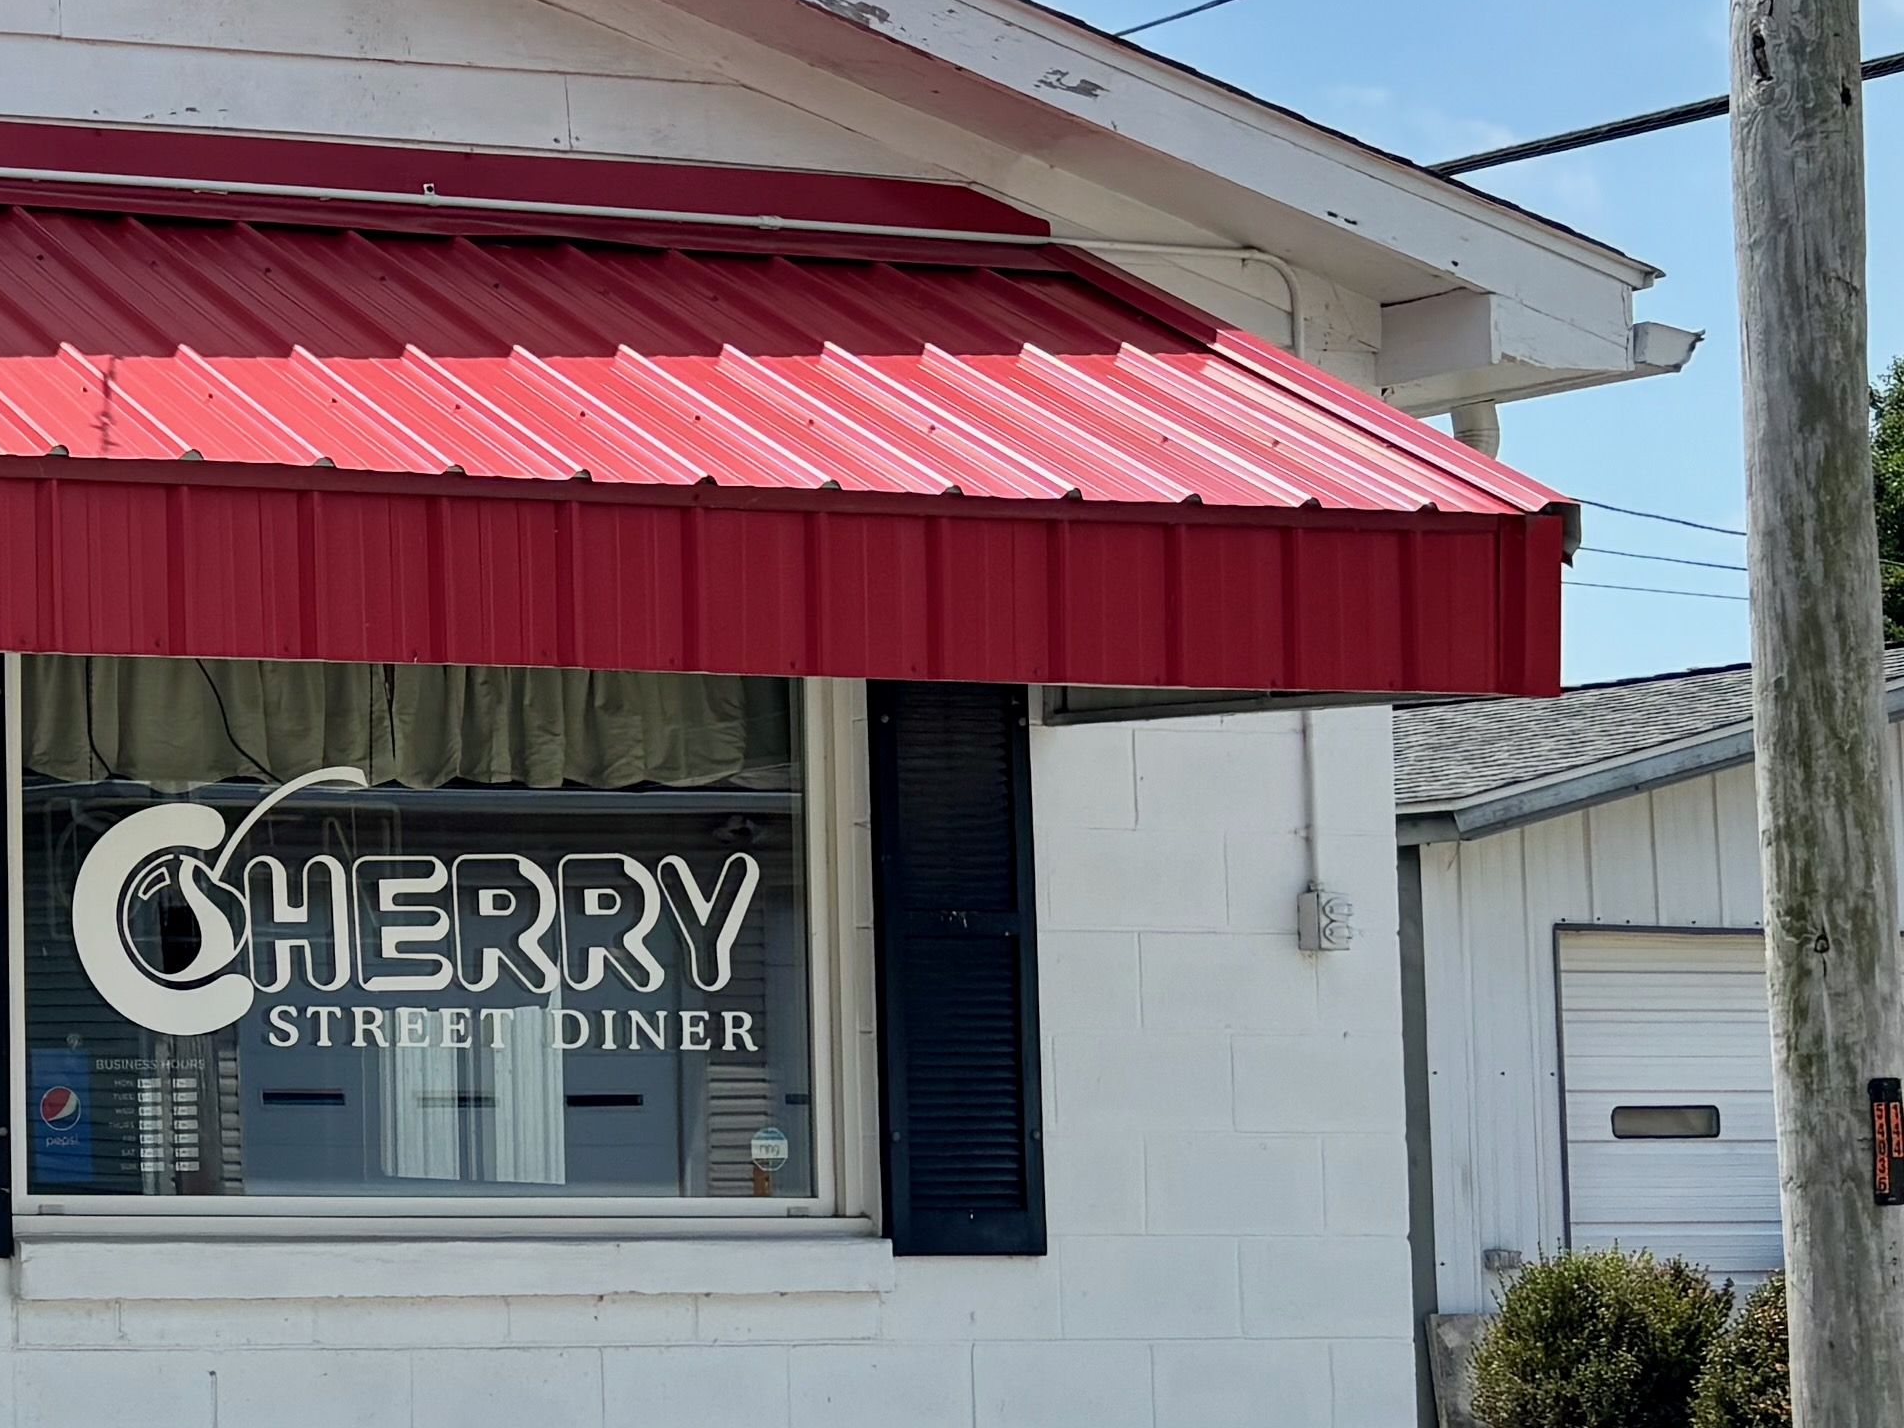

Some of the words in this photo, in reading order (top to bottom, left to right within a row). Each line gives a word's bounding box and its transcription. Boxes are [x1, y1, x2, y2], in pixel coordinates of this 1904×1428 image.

[71, 802, 761, 1037] CHERRY
[268, 1004, 515, 1050] STREET
[550, 1009, 759, 1053] DINER
[95, 1058, 158, 1070] BUSINESS
[160, 1058, 206, 1070] HOURS
